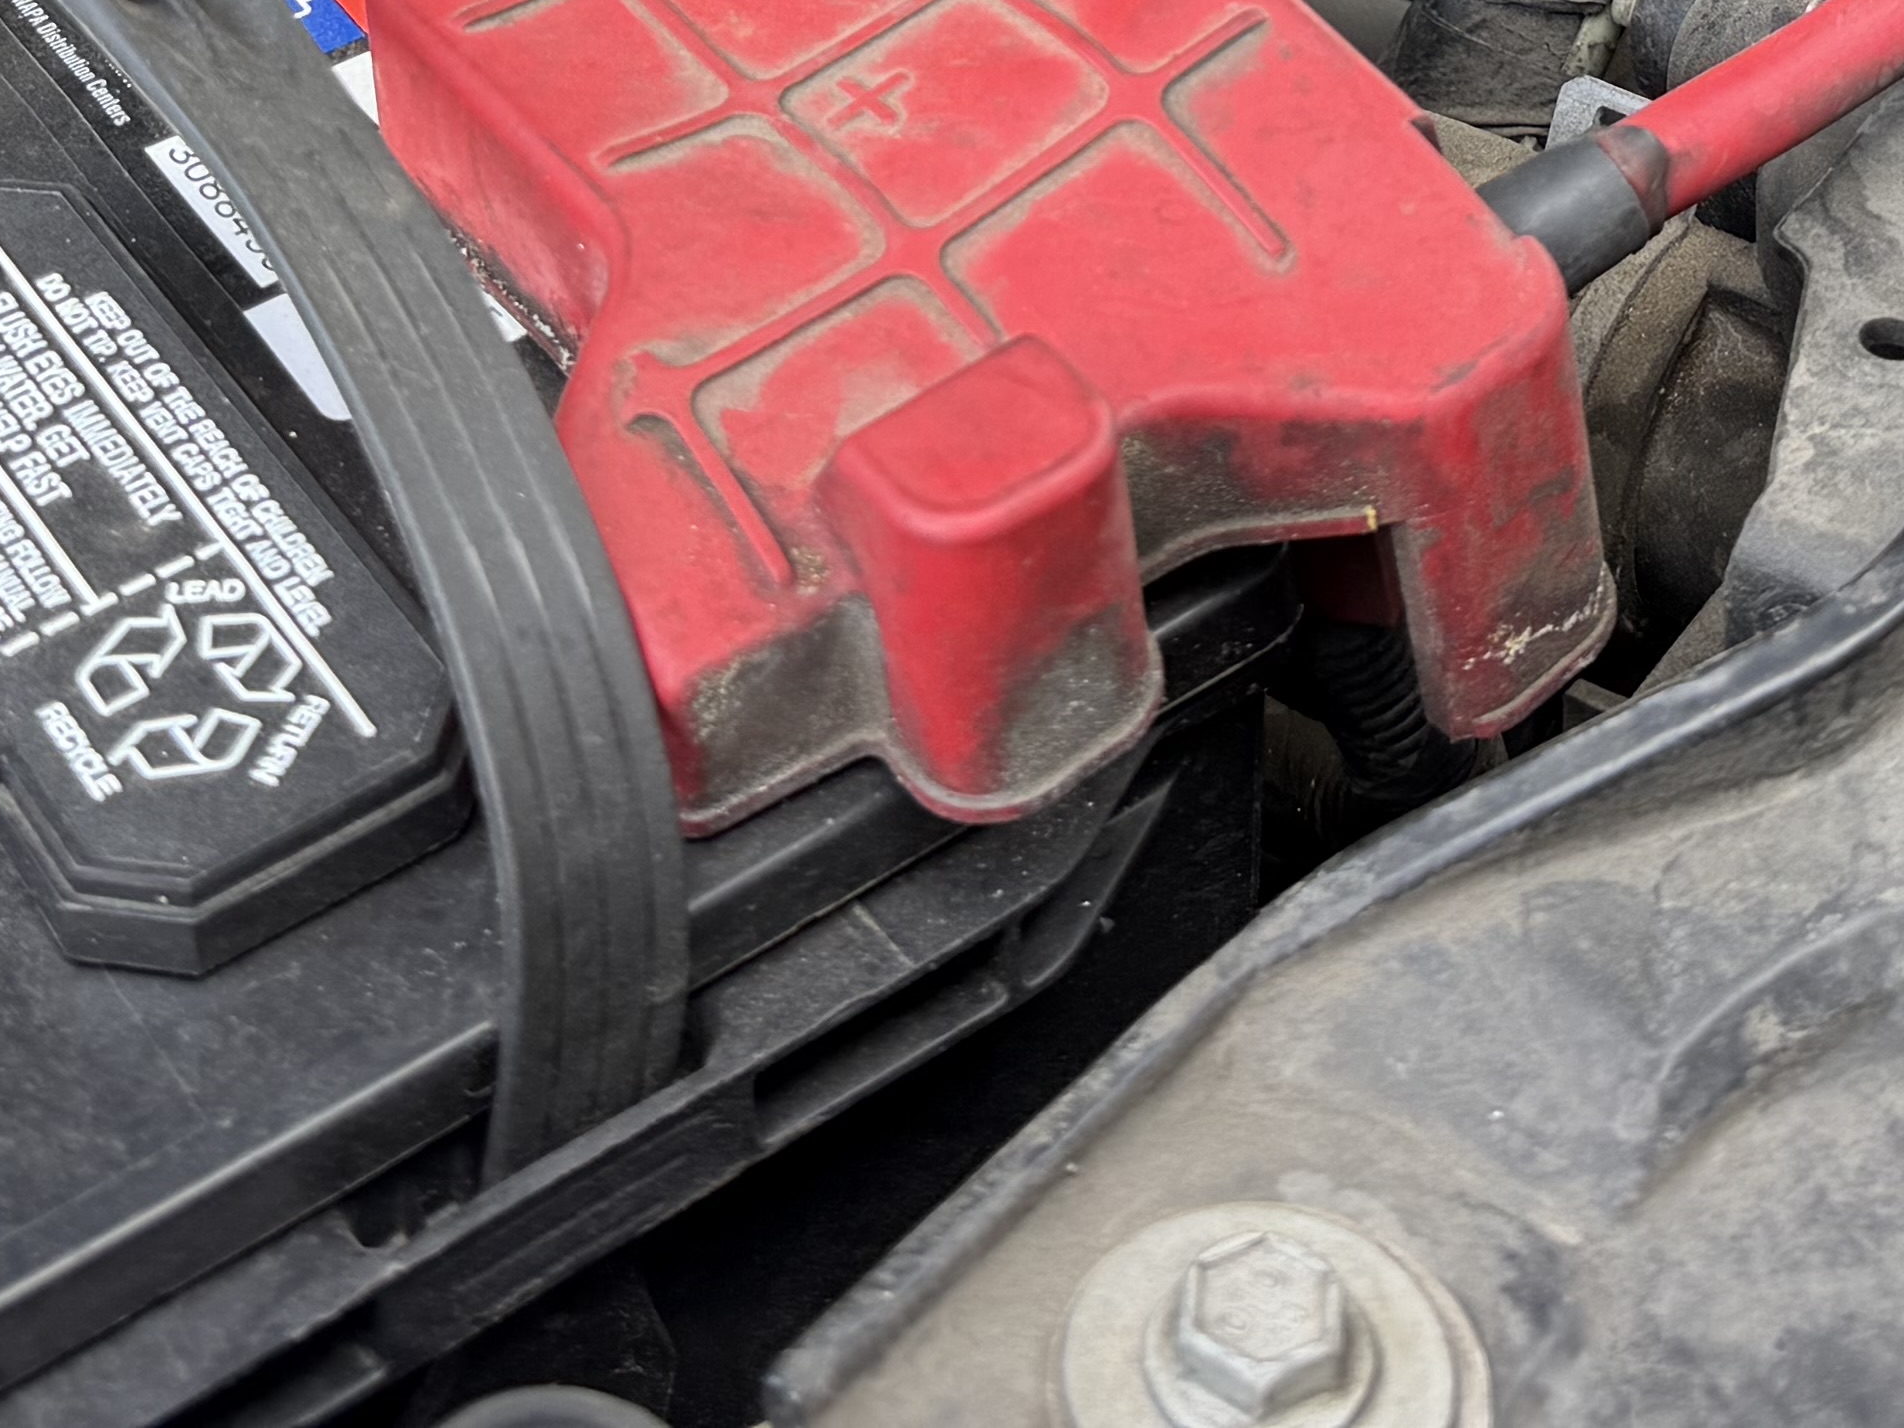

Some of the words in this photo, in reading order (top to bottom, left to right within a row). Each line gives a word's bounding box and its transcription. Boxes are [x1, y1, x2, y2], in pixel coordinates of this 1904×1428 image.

[35, 20, 98, 82] Distribution
[83, 77, 136, 126] Centers
[24, 351, 86, 407] EYES
[63, 400, 184, 528] IMMEDIATELY
[36, 273, 72, 303] DO
[55, 298, 100, 335] NOT
[107, 361, 156, 404] KEEP
[139, 401, 190, 445] VENT
[171, 443, 223, 492] CAPS
[207, 487, 265, 542] TIGHT
[245, 540, 293, 581] AND
[36, 425, 92, 469] GET
[85, 292, 133, 332] KEEP
[117, 330, 161, 365] OUT
[143, 363, 181, 389] OF
[163, 386, 207, 426] THE
[189, 419, 249, 480] REACH
[231, 474, 271, 503] OF
[251, 500, 335, 588] CHILDREN
[9, 451, 74, 508] FAST
[5, 539, 73, 610] FOLLOW
[166, 578, 248, 604] LEAD
[35, 700, 123, 802] RECYCLE
[249, 691, 331, 788] RETURN
